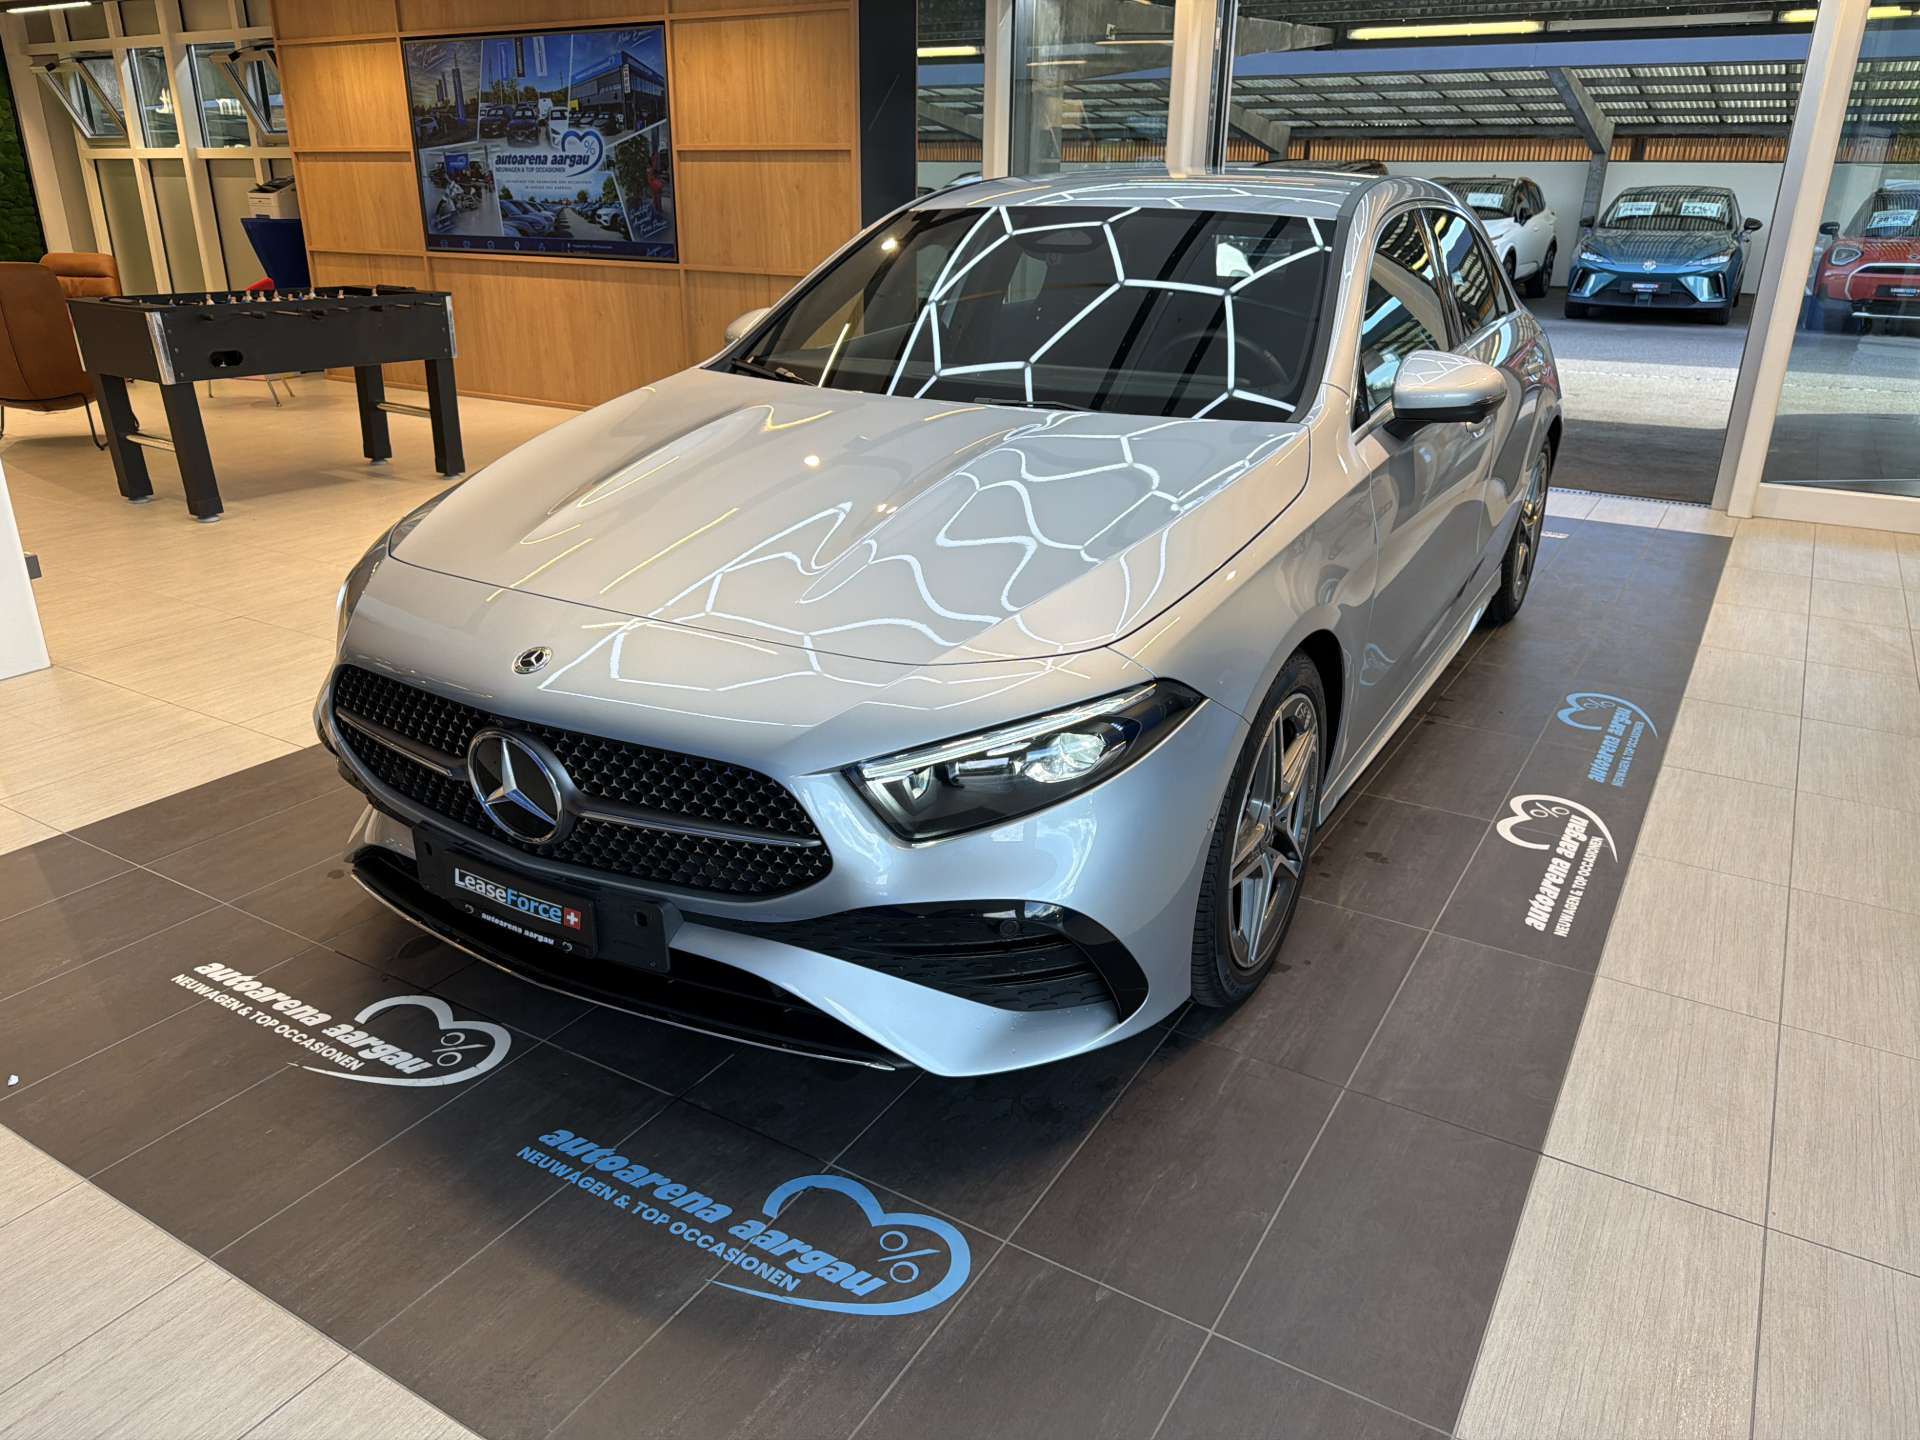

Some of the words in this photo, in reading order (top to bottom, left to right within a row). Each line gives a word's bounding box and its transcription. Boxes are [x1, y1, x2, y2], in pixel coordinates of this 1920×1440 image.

[495, 153, 548, 166] autoarena
[550, 153, 590, 168] aargau
[1587, 734, 1621, 784] autoarena
[1607, 705, 1633, 737] aargau
[1524, 856, 1571, 932] autoarena
[1555, 814, 1589, 859] aargau
[1571, 875, 1588, 890] TOP
[1577, 835, 1604, 877] OCCASIONEN
[454, 867, 562, 923] LeaseForce
[1553, 894, 1581, 938] NEUWAGEN
[1569, 889, 1584, 897] &
[481, 912, 523, 934] autoarena
[523, 928, 555, 946] aargau
[170, 973, 246, 1012] NEUWAGEN
[237, 1006, 254, 1017] &
[248, 1010, 280, 1027] TOP
[274, 1024, 366, 1072] OCCASIONEN
[193, 962, 333, 1027] autoarena
[321, 1023, 433, 1075] aargau
[516, 1146, 618, 1201] NEUWAGEN
[613, 1194, 631, 1209] &
[631, 1201, 672, 1226] TOP
[668, 1221, 802, 1293] OCCASIONEN
[538, 1129, 734, 1224] autoarena
[727, 1219, 888, 1297] aargau
